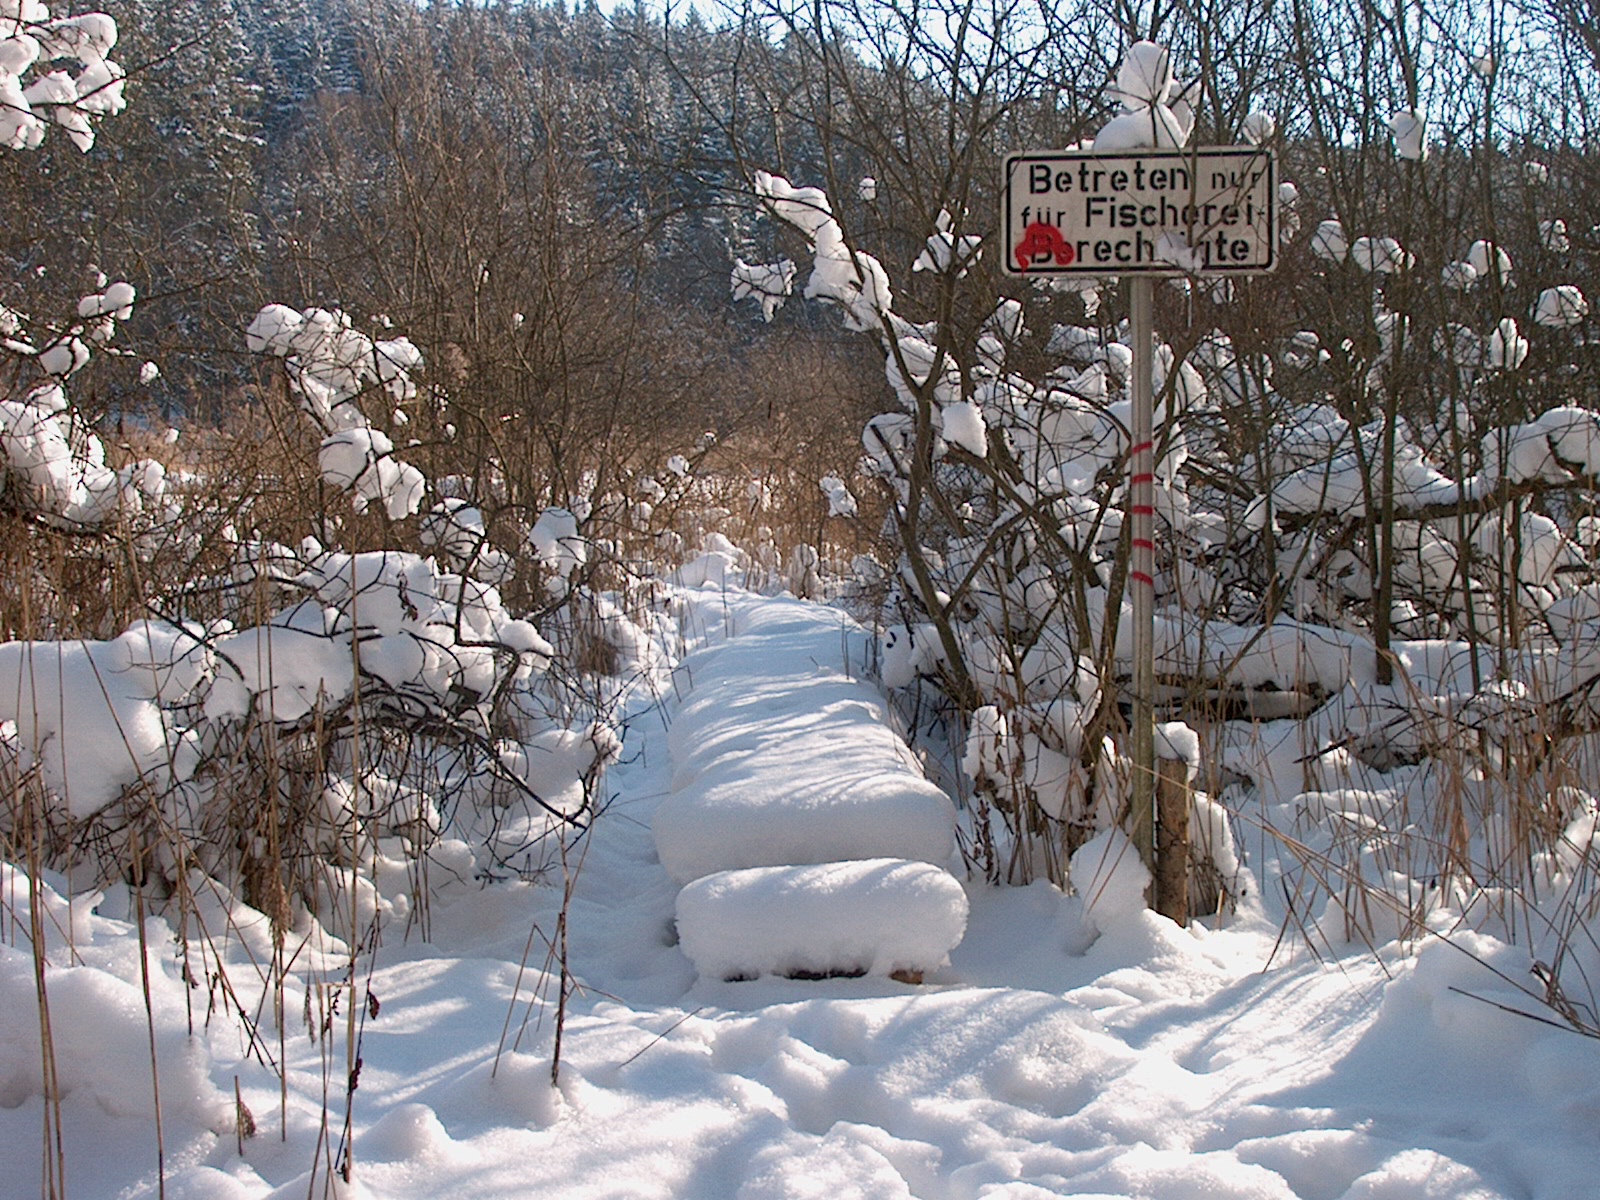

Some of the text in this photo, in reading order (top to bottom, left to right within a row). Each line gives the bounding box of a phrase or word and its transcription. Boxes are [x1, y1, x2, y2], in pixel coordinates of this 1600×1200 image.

[1029, 161, 1262, 194] Betreten nur
[1021, 195, 1265, 229] für Fischerei-
[1030, 231, 1250, 266] Brechte
